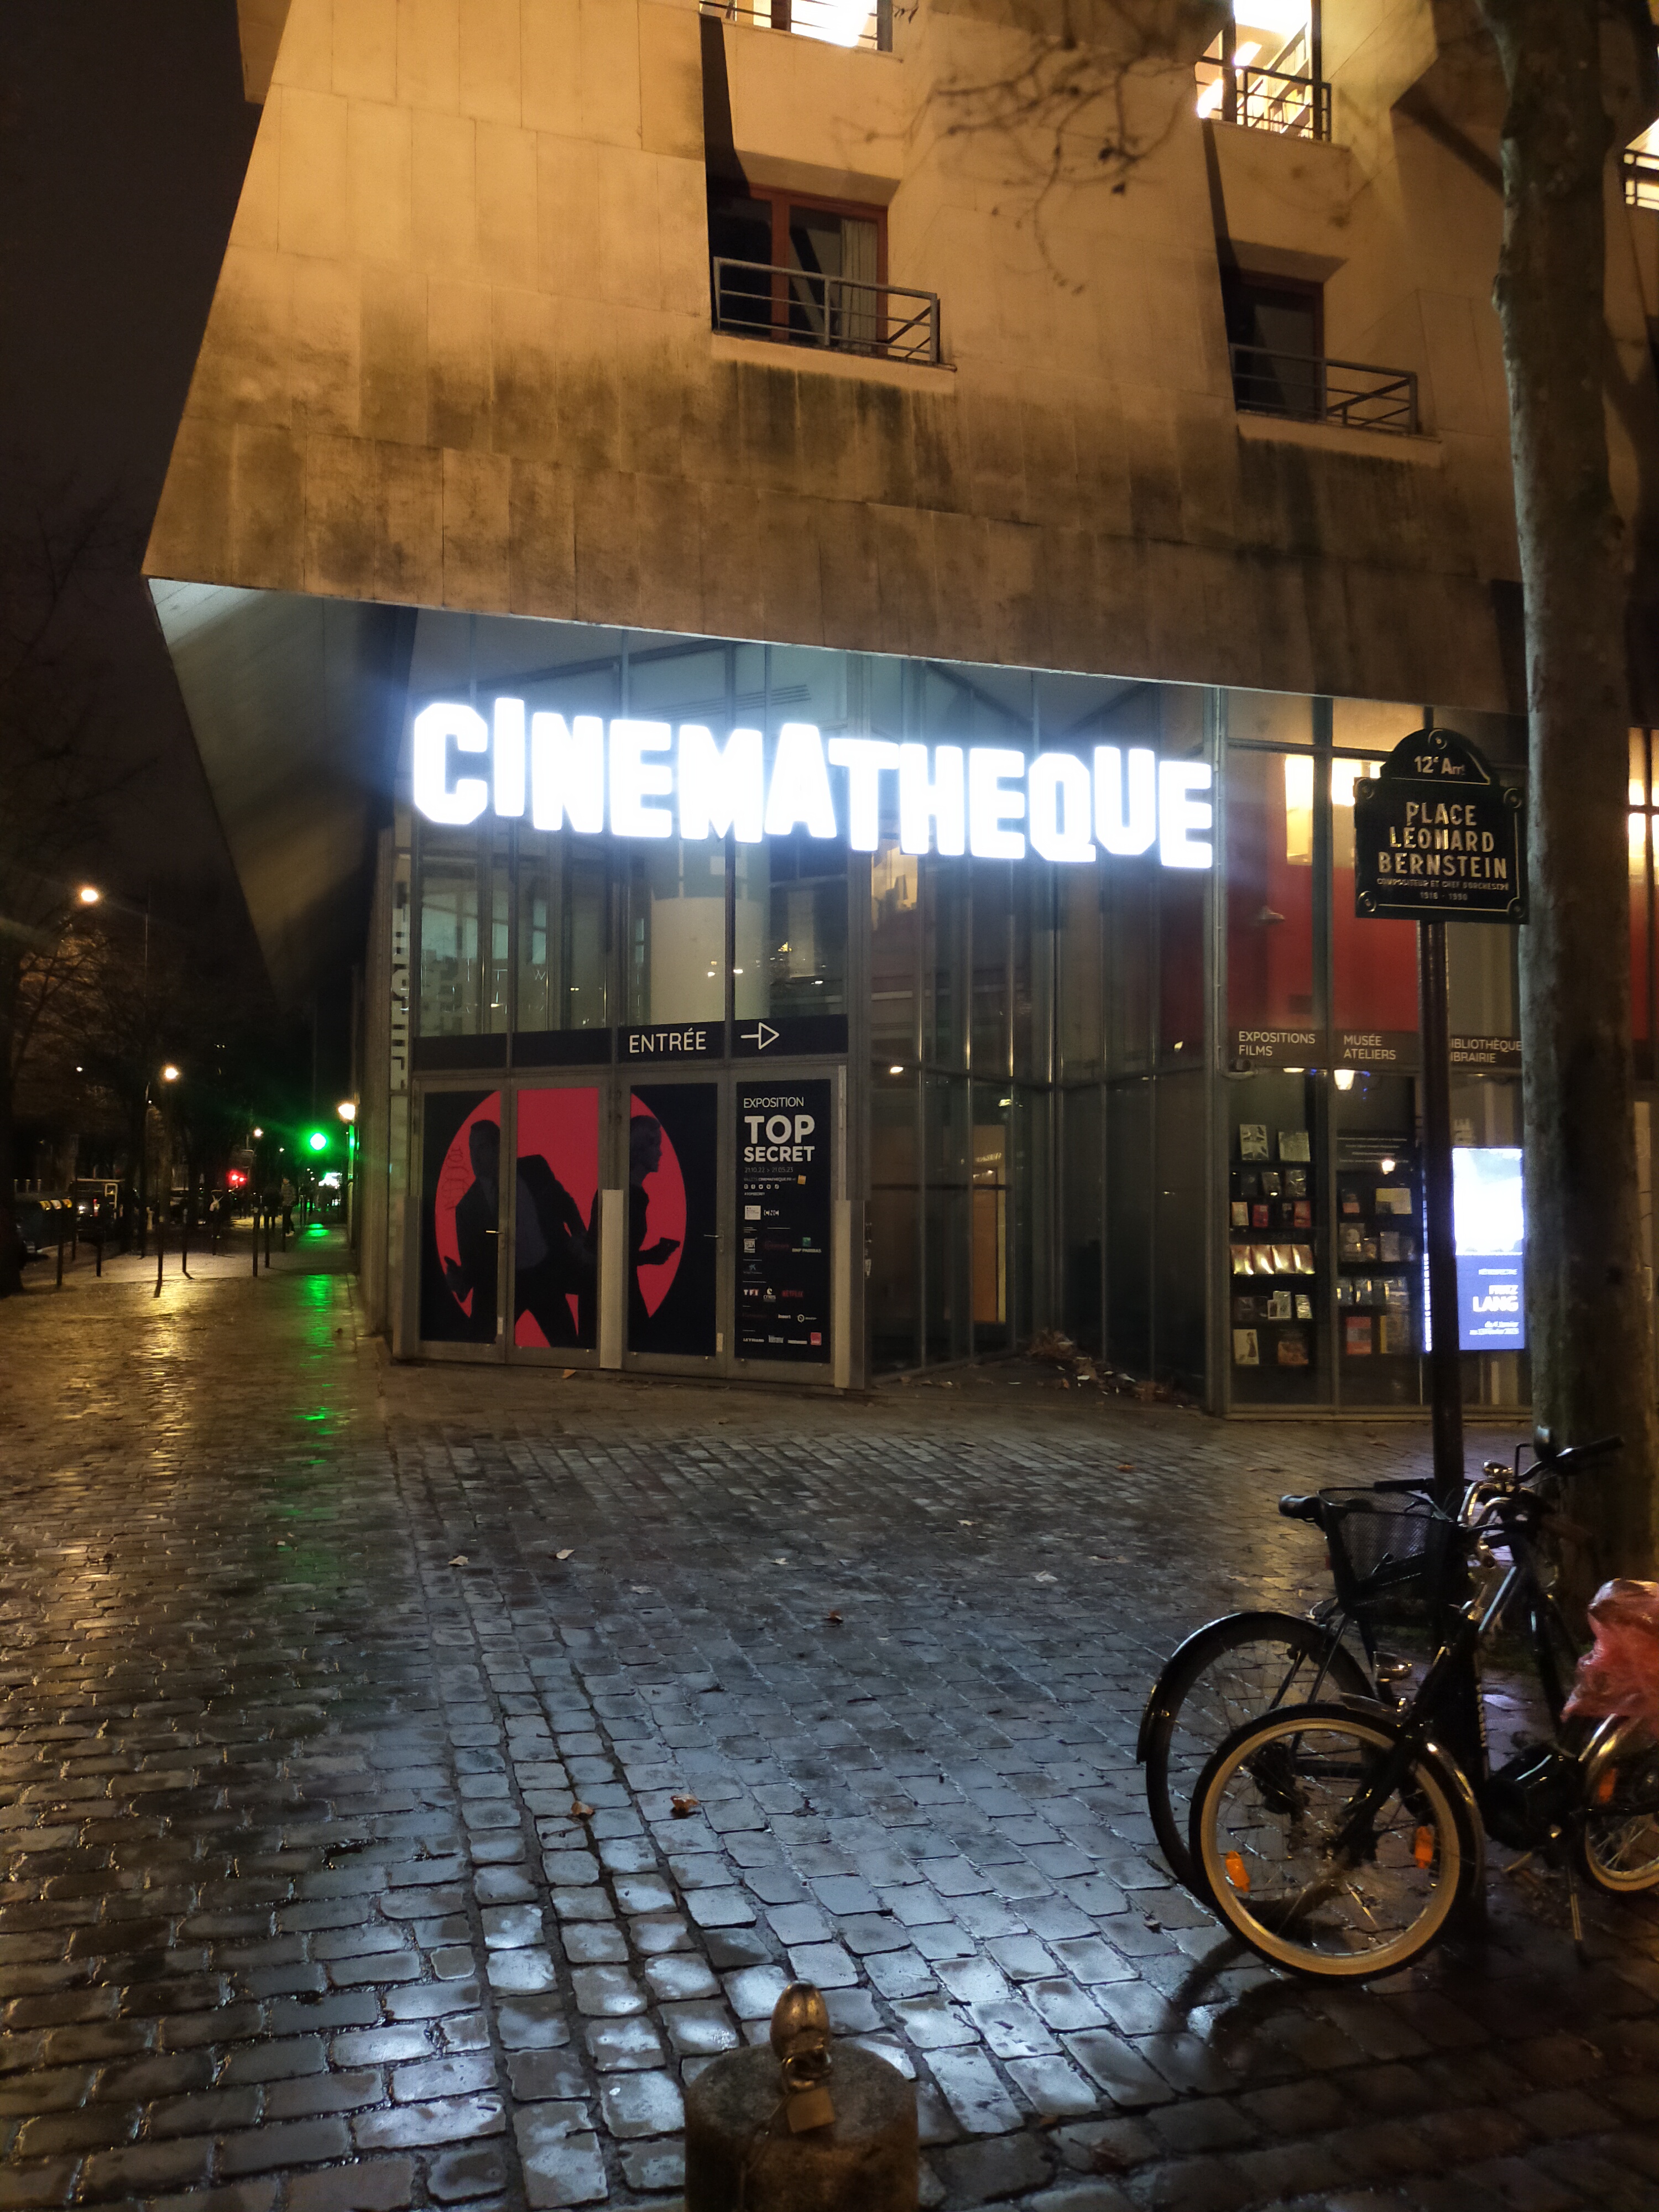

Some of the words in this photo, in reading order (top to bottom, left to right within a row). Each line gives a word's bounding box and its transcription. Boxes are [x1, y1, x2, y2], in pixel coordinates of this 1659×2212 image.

[414, 698, 1213, 869] CINEMATHEQUE
[1406, 802, 1477, 826] PLACE
[1389, 826, 1494, 852] LEONARD
[1378, 852, 1507, 879] BERNSTEIN
[629, 1027, 707, 1053] ENTRÉE
[1238, 1030, 1316, 1044] EXPOSITIONS
[1344, 1033, 1383, 1046] MUSÉE
[1239, 1045, 1273, 1056] FILMS
[1343, 1048, 1396, 1060] ATELIERS
[743, 1097, 804, 1108] EXPOSITION
[744, 1114, 815, 1144] TOP
[744, 1146, 815, 1162] SECRET
[1473, 1295, 1519, 1312] LANG
